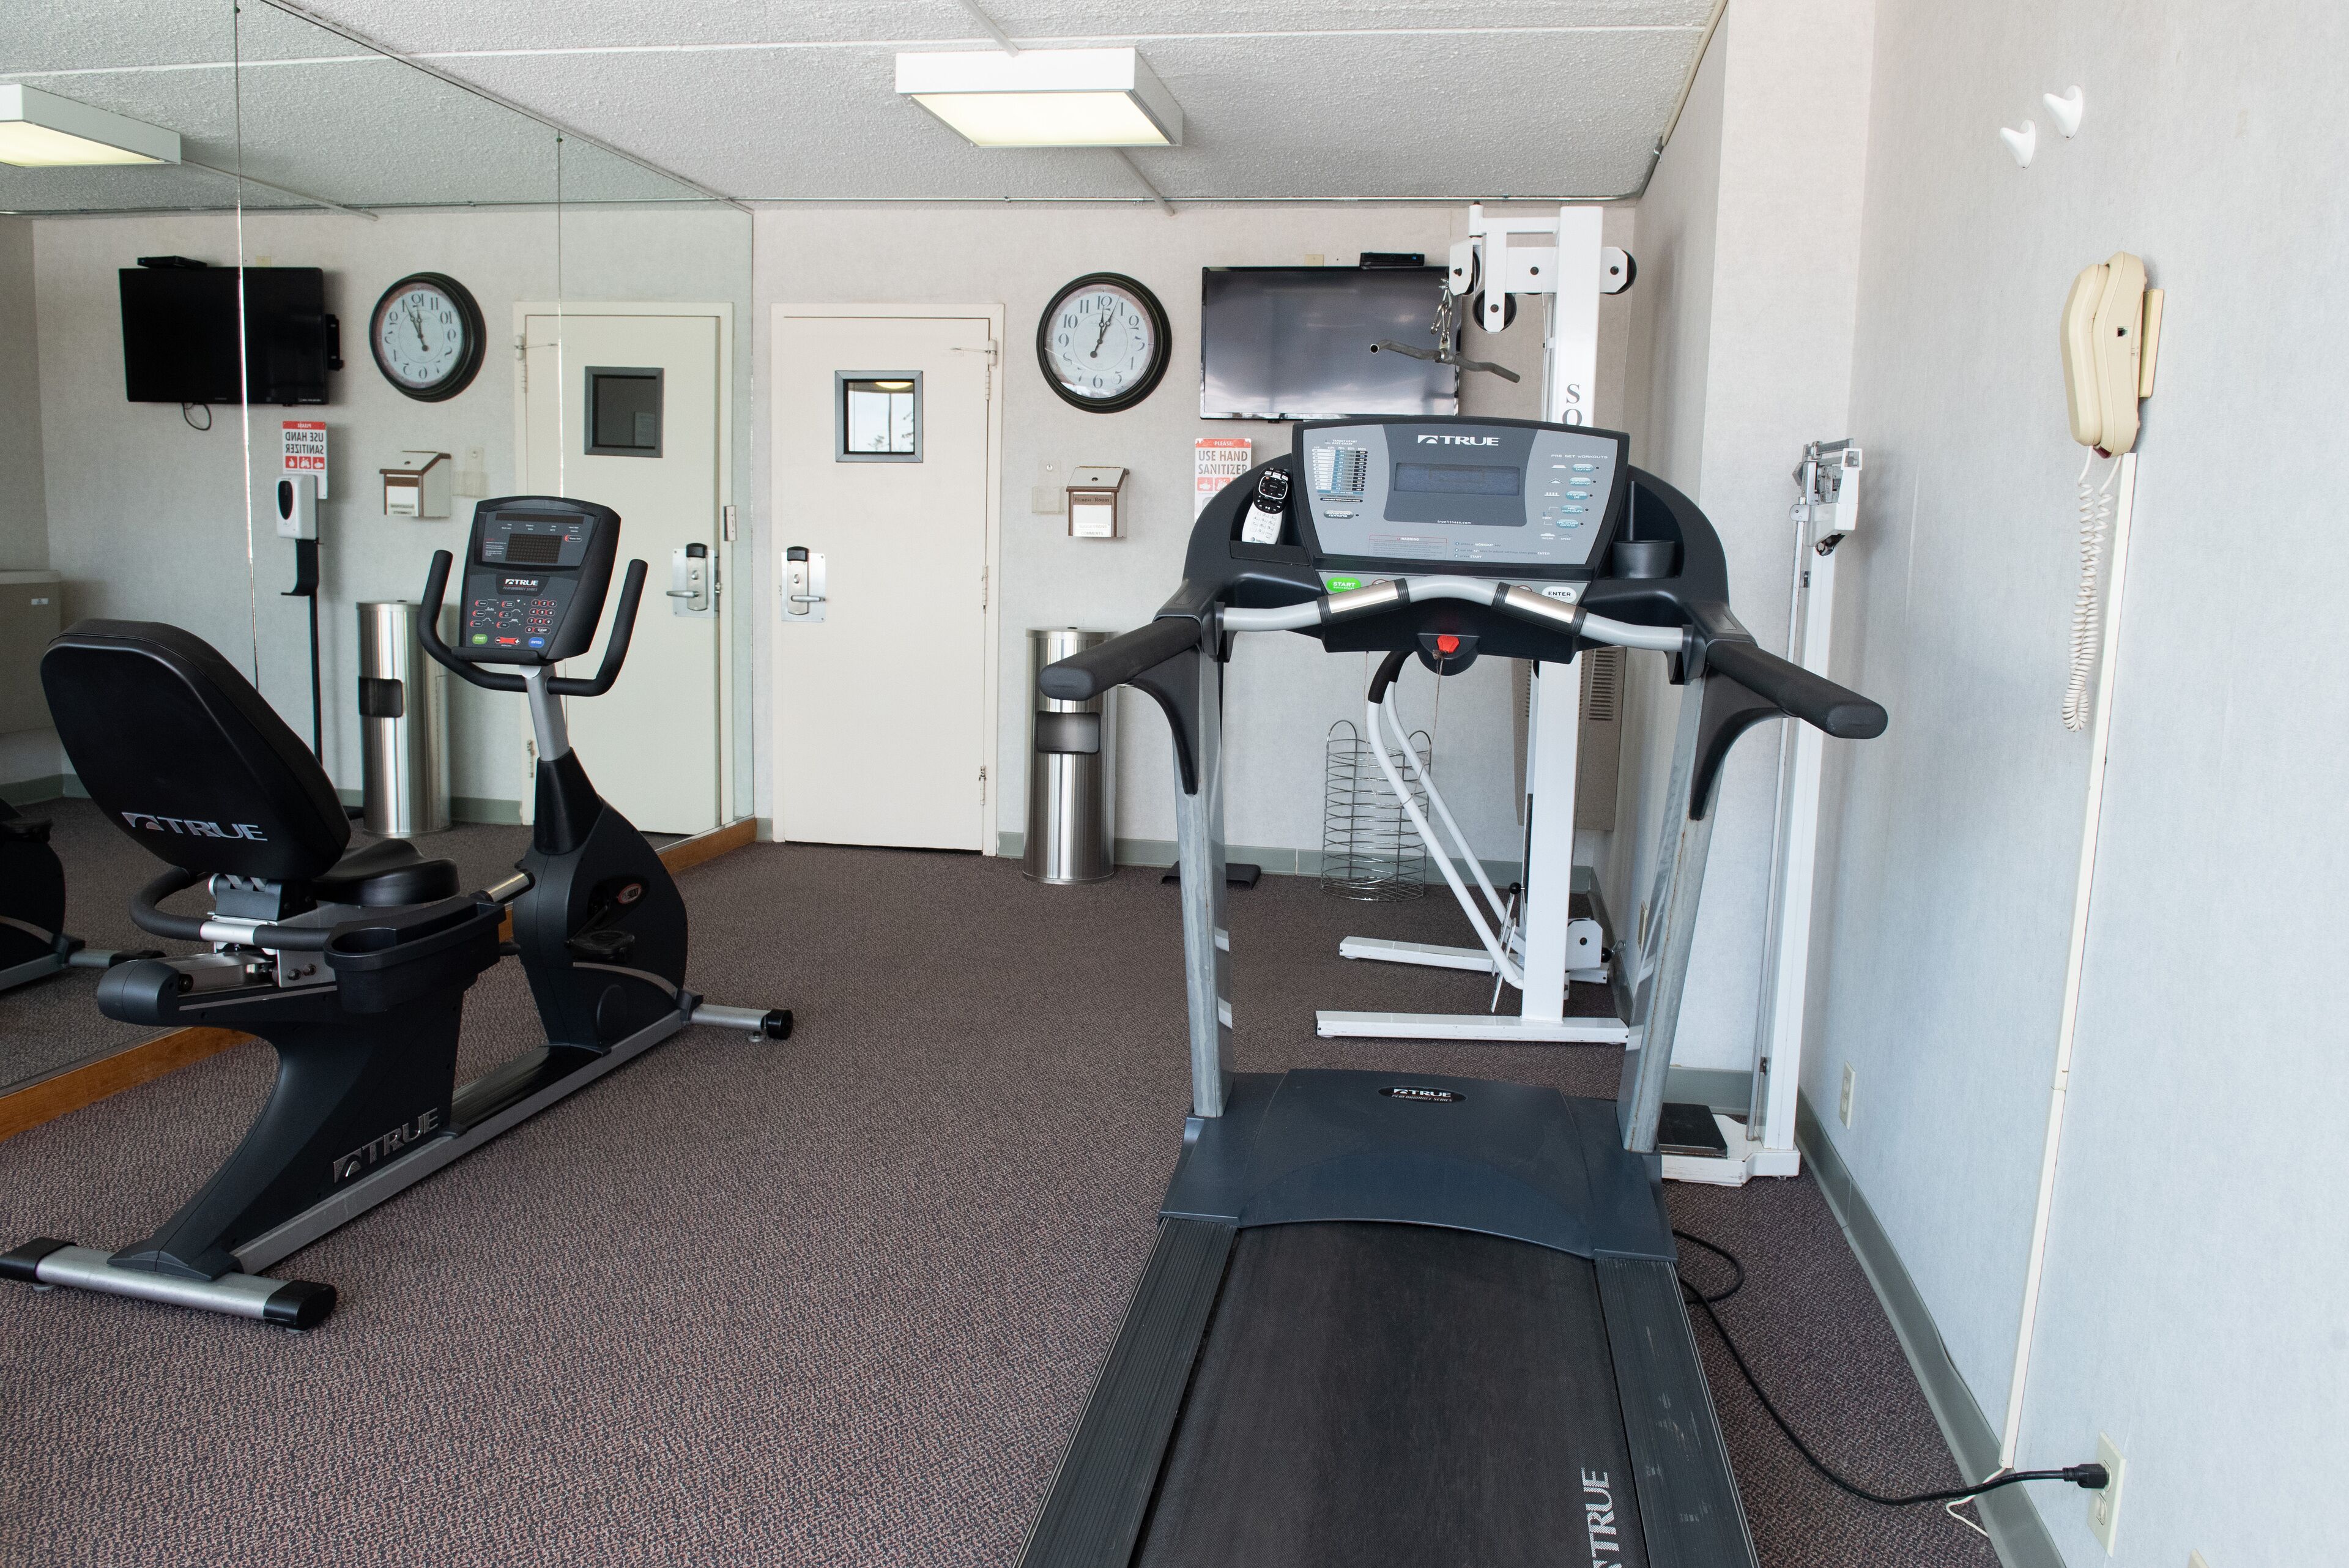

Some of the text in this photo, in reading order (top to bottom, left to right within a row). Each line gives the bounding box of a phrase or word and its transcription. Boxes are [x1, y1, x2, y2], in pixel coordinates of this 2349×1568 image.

[1080, 300, 1089, 314] 11
[1097, 295, 1113, 311] 12
[1120, 302, 1124, 316] 1
[1063, 314, 1078, 329] 10
[1129, 314, 1140, 330] 2
[1058, 333, 1069, 347] 9
[1093, 374, 1104, 388] 6
[1439, 436, 1500, 446] TRUE
[1198, 450, 1248, 461] USE HAND
[1198, 464, 1247, 475] SANITIZER
[157, 816, 268, 841] TRUE
[362, 1107, 439, 1164] TRUE
[1581, 1467, 1620, 1558] TRUE
